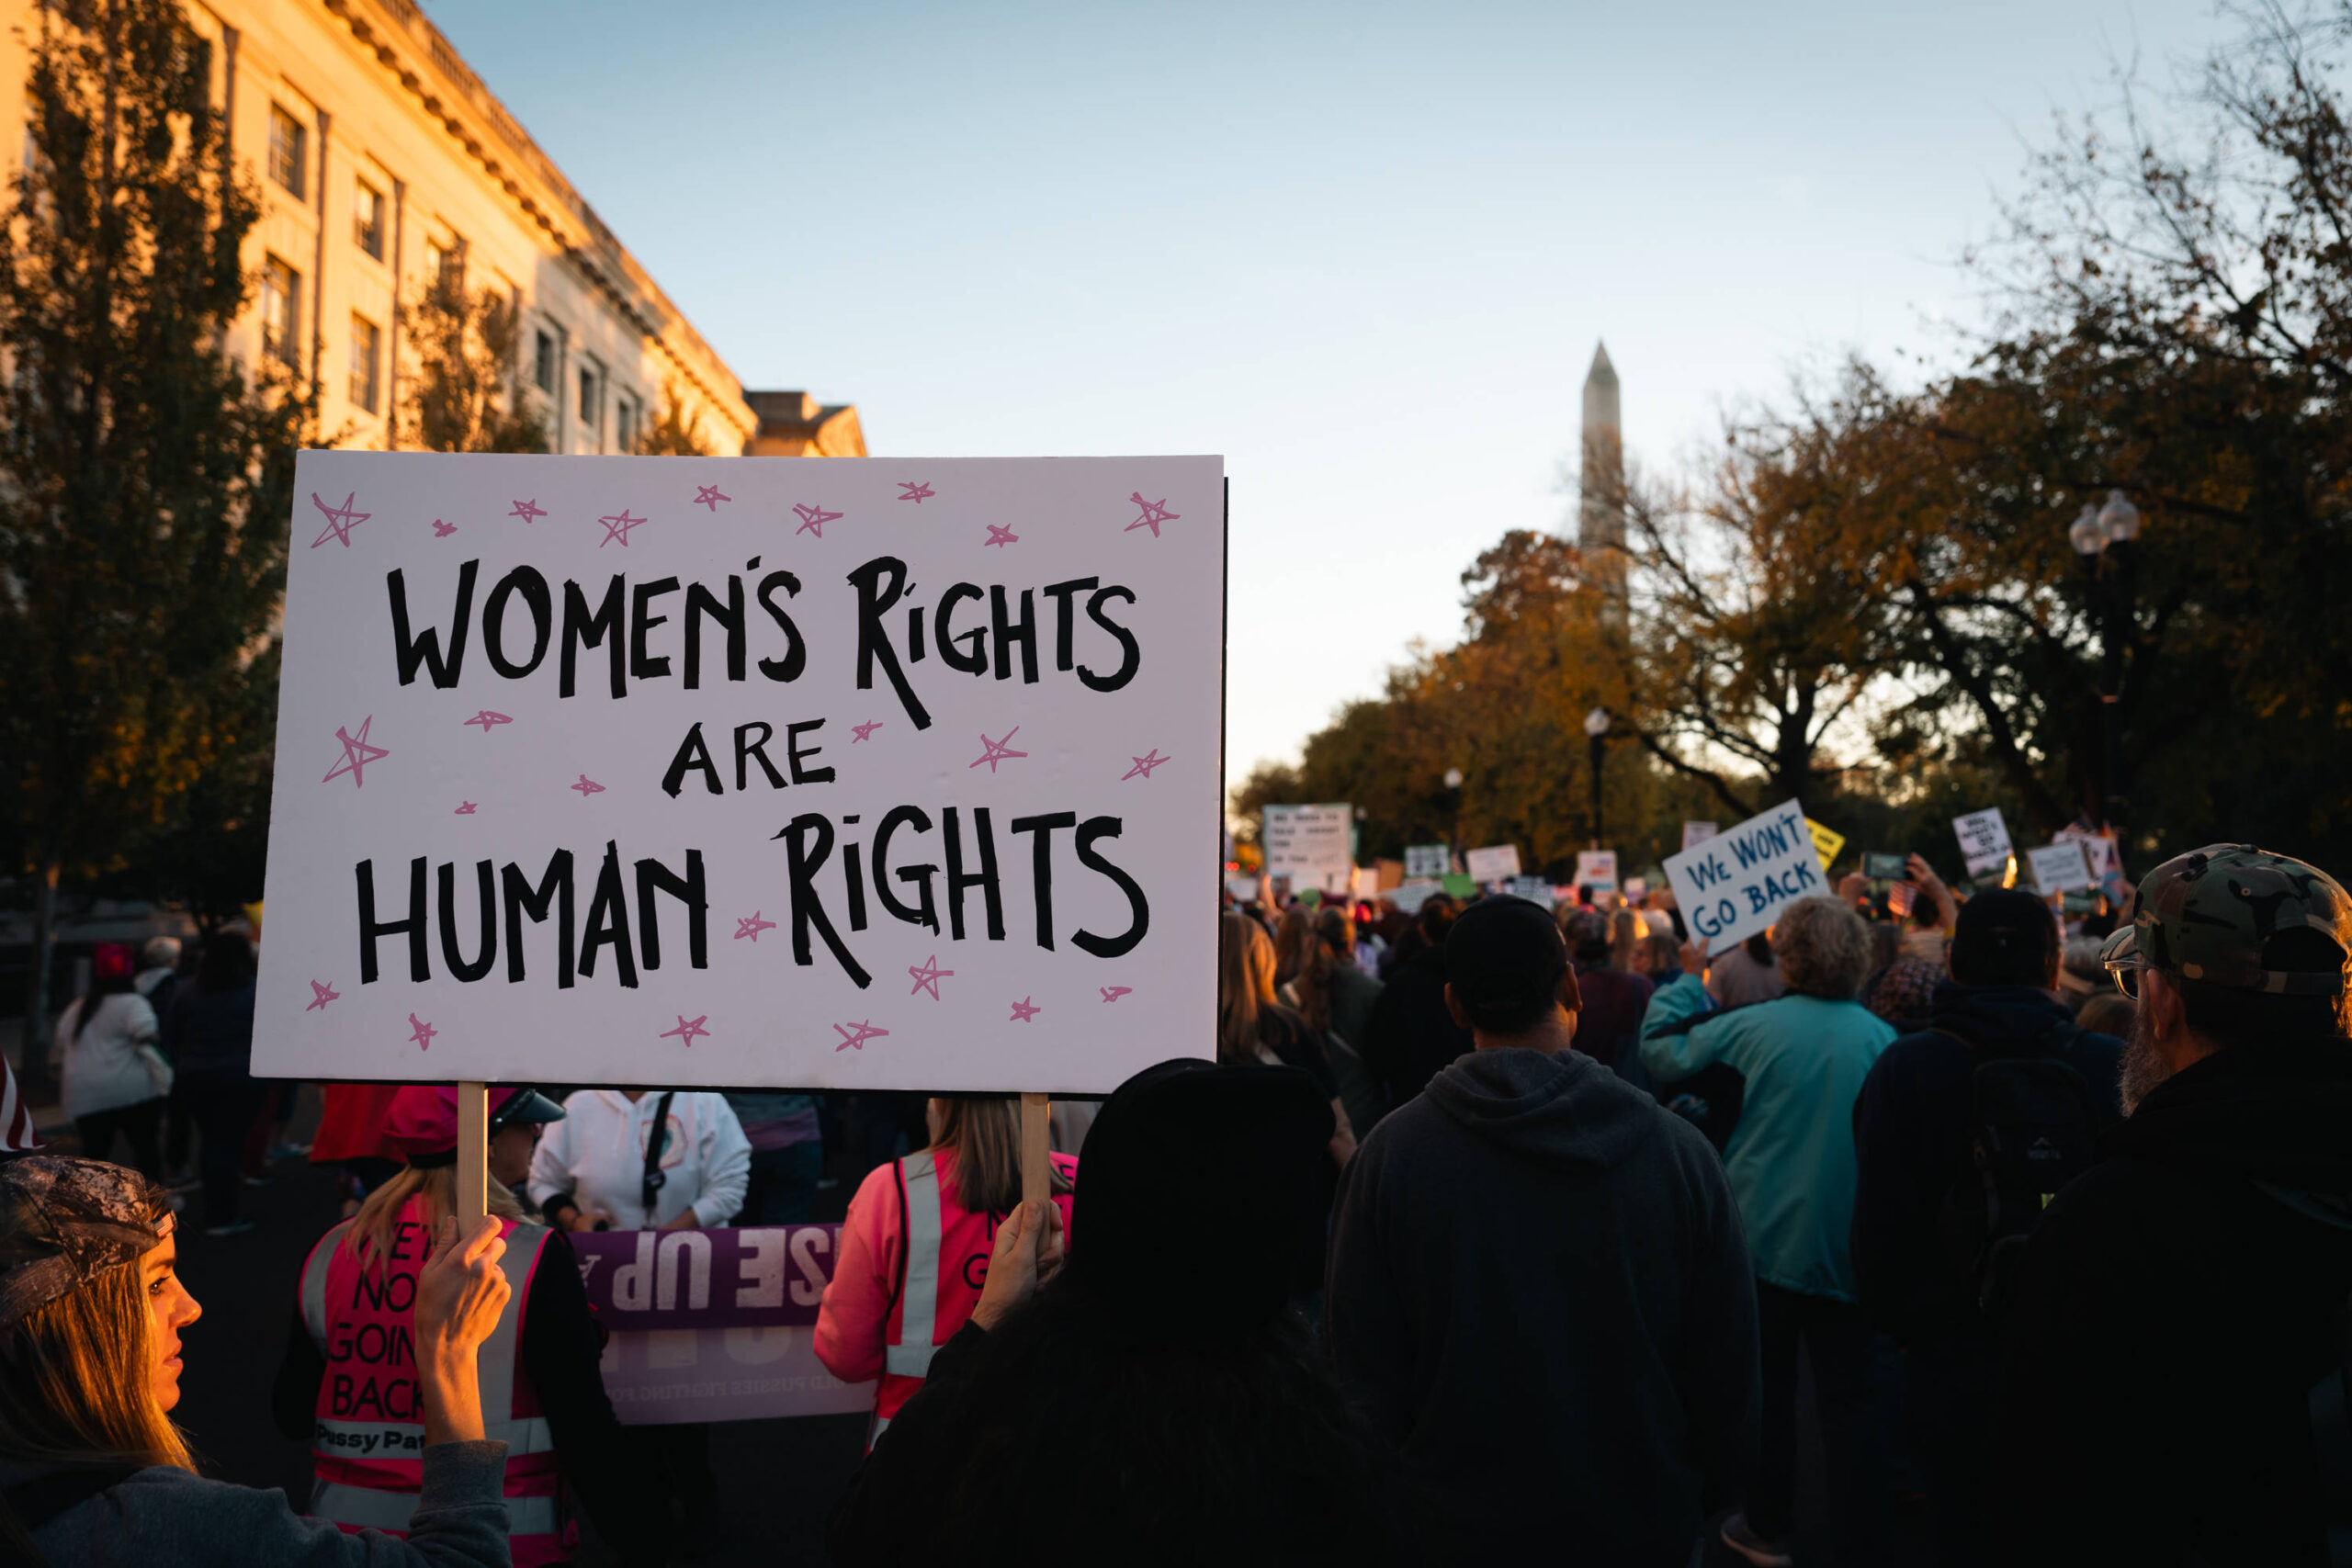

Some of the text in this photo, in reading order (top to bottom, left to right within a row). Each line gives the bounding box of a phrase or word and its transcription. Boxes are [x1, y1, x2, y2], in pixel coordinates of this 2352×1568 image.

[387, 556, 806, 699] WOMEN'S
[662, 718, 835, 798] ARE
[1686, 852, 1731, 892] WE
[1729, 813, 1801, 870] WON'T
[356, 840, 708, 989] HUMAN
[1693, 861, 1816, 937] GO BACK
[353, 1271, 416, 1313] NO
[612, 1231, 712, 1312] UP
[330, 1322, 418, 1368] GOIN
[316, 1424, 425, 1454] Pussy Pat
